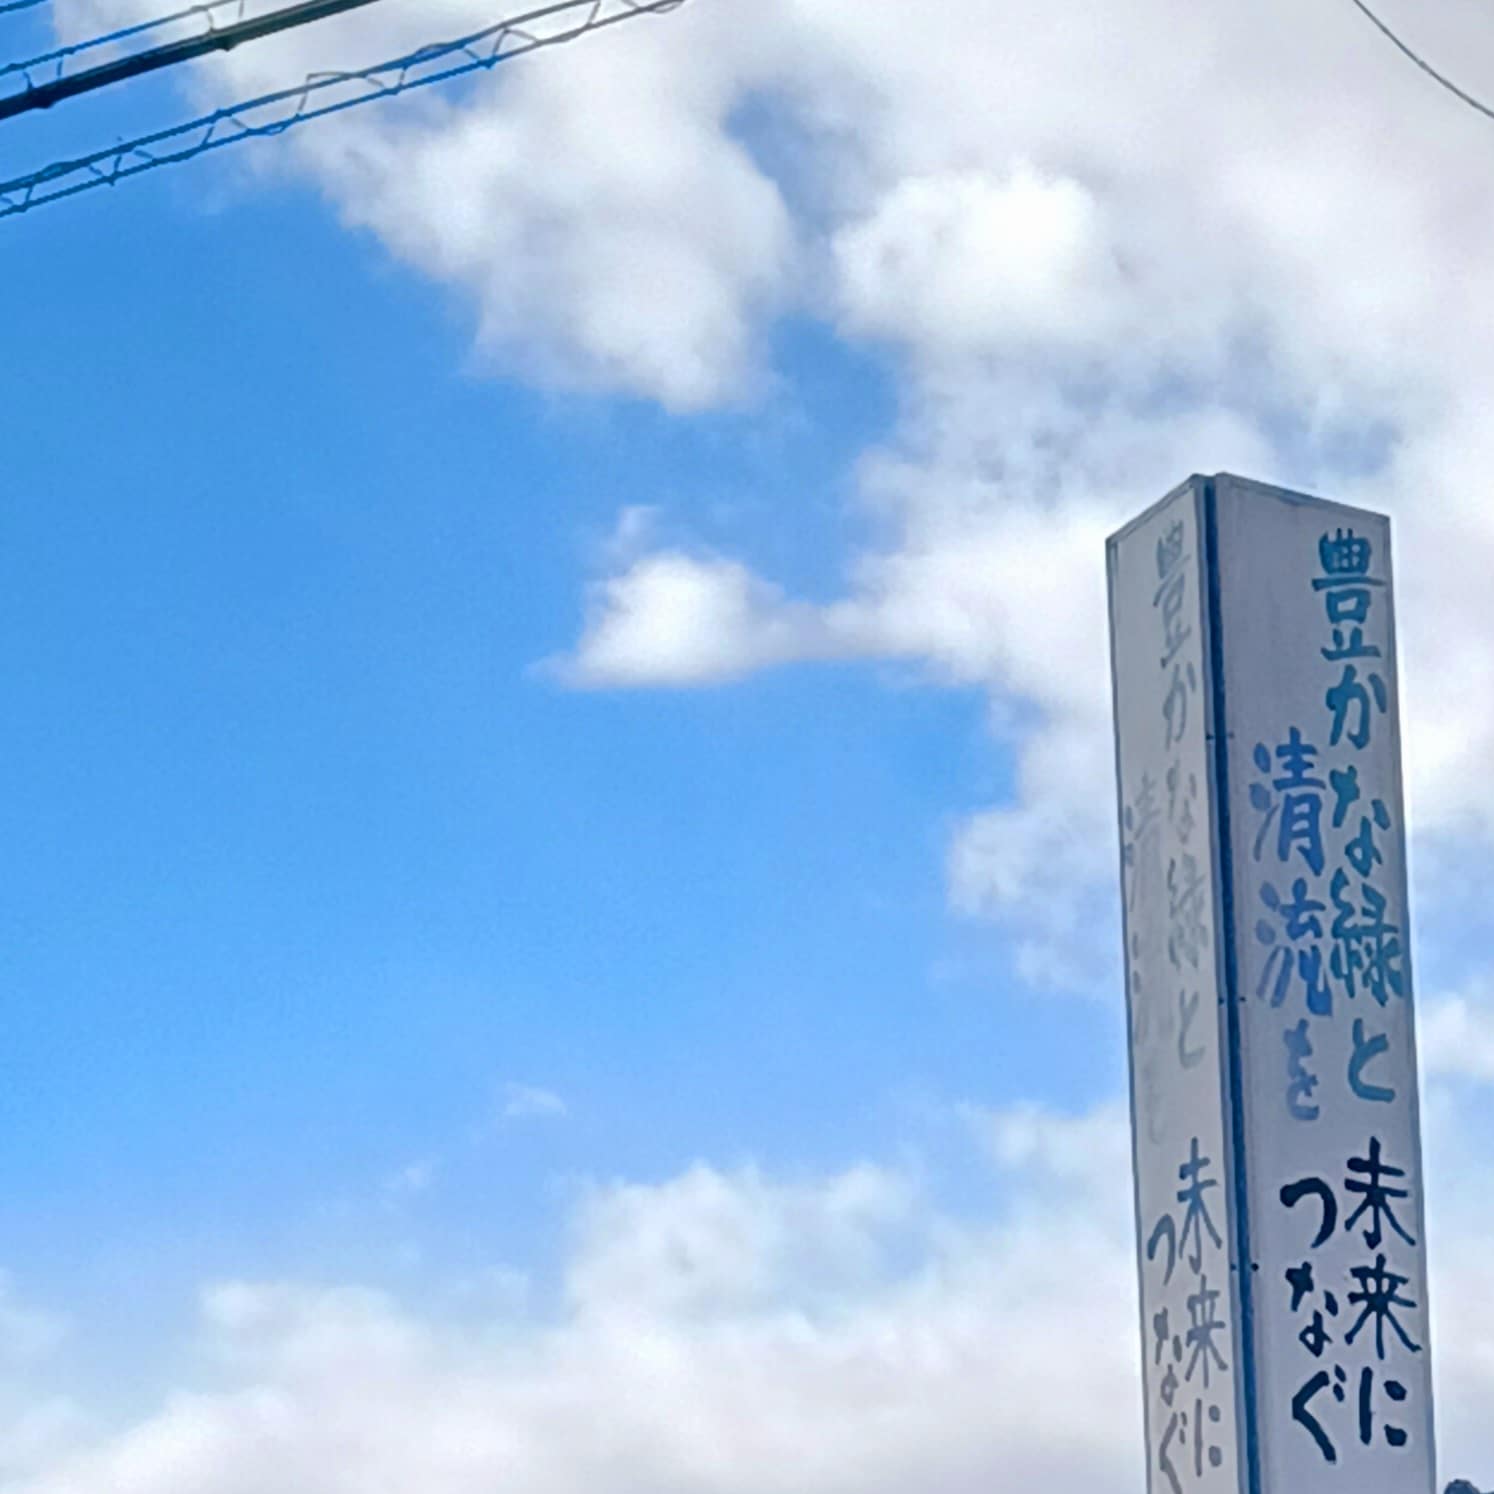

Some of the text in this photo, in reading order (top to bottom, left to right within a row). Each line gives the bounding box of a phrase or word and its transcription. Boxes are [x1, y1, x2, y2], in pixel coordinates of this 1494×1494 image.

[1248, 726, 1333, 1122] 清流を
[1311, 527, 1405, 1103] 豊かな緑と
[1176, 1136, 1228, 1479] 未来に
[1279, 1176, 1347, 1464] つなぐ
[1343, 1135, 1423, 1448] 未来に
